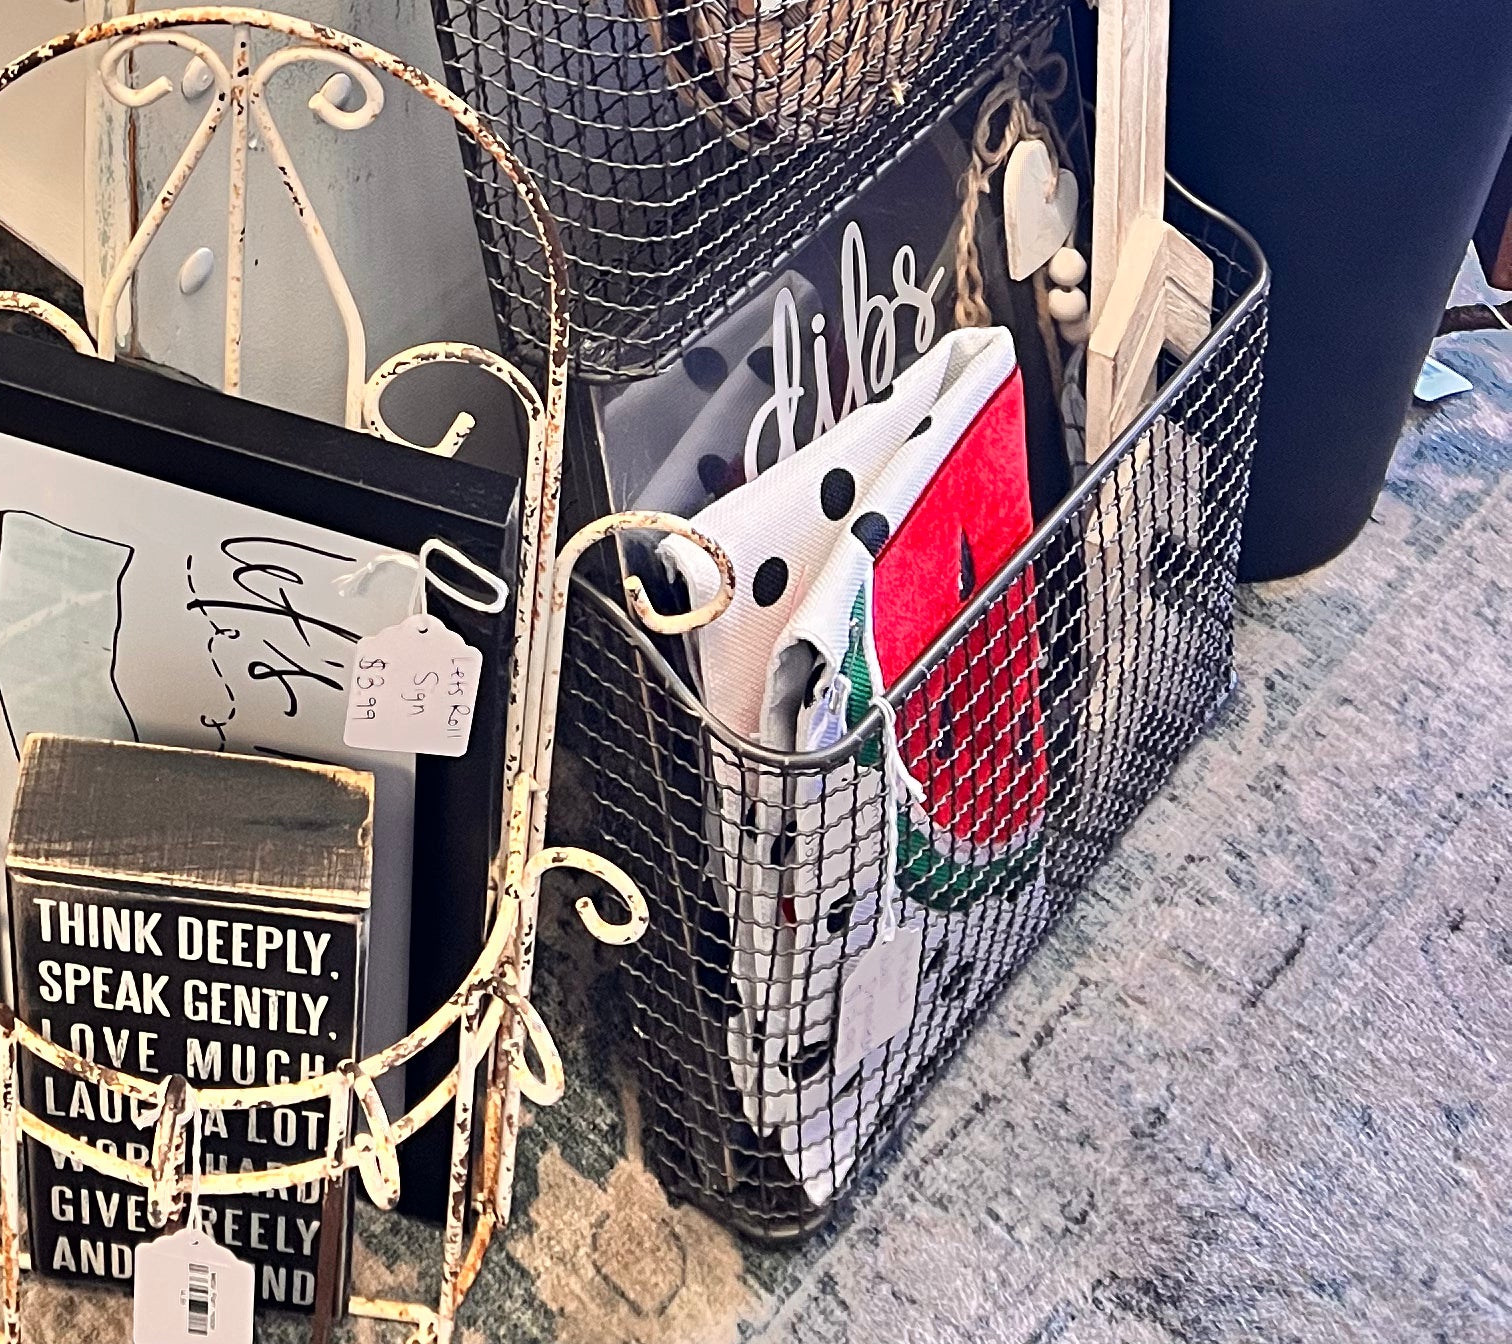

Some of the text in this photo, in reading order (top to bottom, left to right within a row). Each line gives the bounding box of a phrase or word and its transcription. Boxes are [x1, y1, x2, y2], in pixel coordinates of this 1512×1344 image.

[744, 220, 946, 484] dibs
[351, 655, 389, 722] $3.99
[400, 670, 440, 716] Sign
[445, 703, 471, 739] Roll
[33, 897, 340, 981] THINK DEEPLY.
[38, 960, 338, 1042] SPEAK GENTLY.
[186, 1037, 325, 1088] MUCH
[44, 1075, 325, 1151] LAU A LOT
[50, 1184, 322, 1257] GIVE REELY
[52, 1235, 134, 1280] AND
